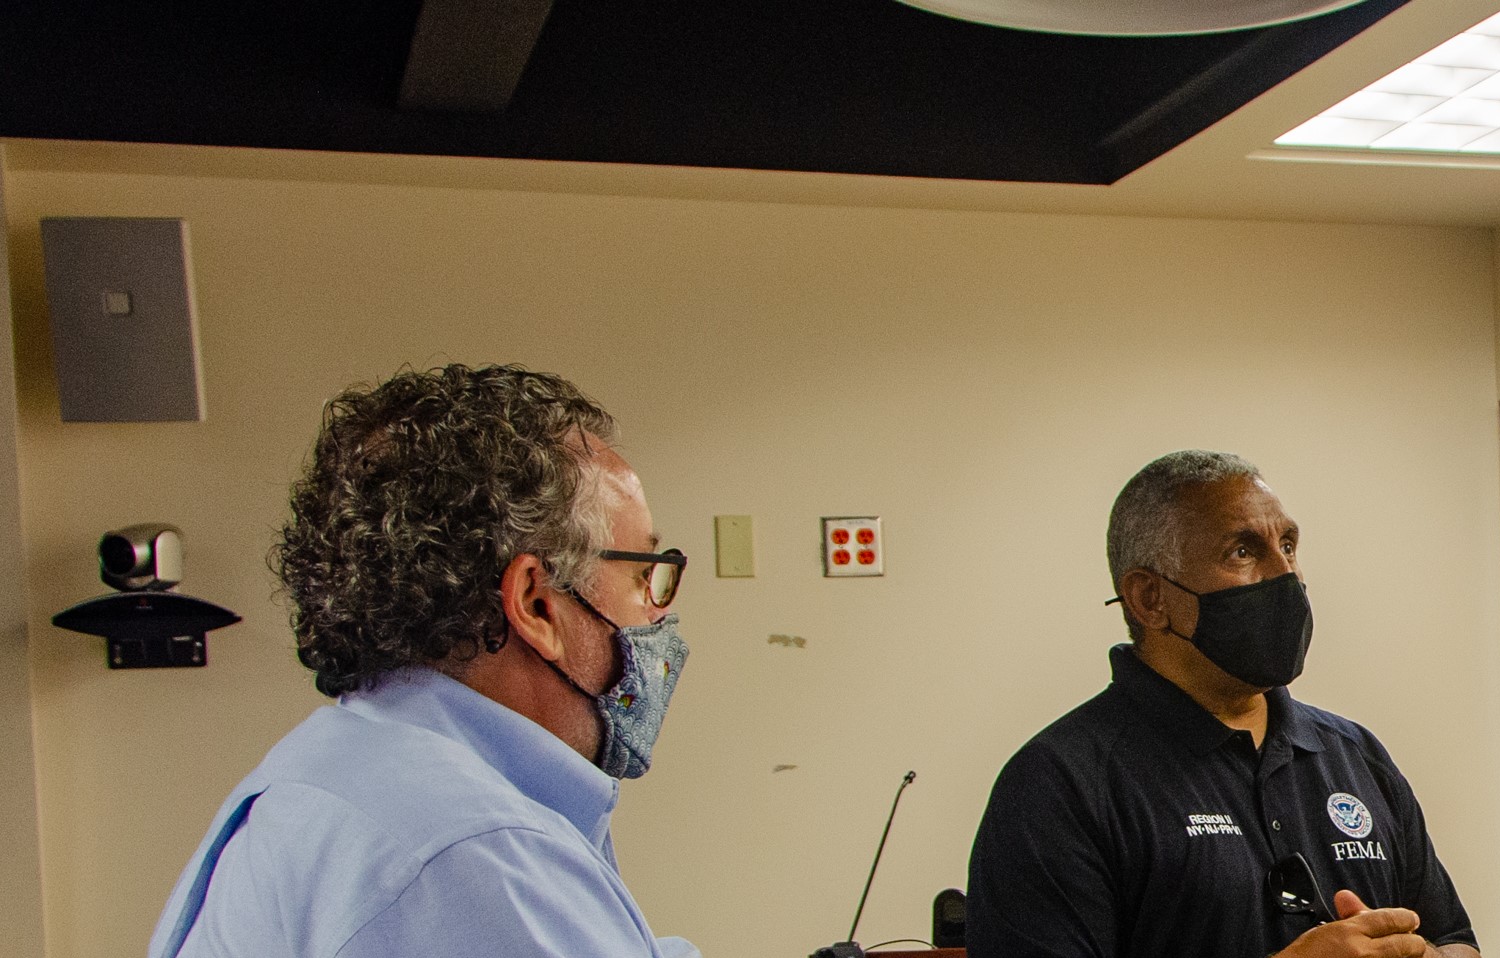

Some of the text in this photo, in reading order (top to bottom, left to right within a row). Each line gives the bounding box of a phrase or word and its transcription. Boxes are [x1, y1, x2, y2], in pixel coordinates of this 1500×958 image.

[1188, 814, 1233, 825] REGION II
[1331, 841, 1387, 861] FEMA
